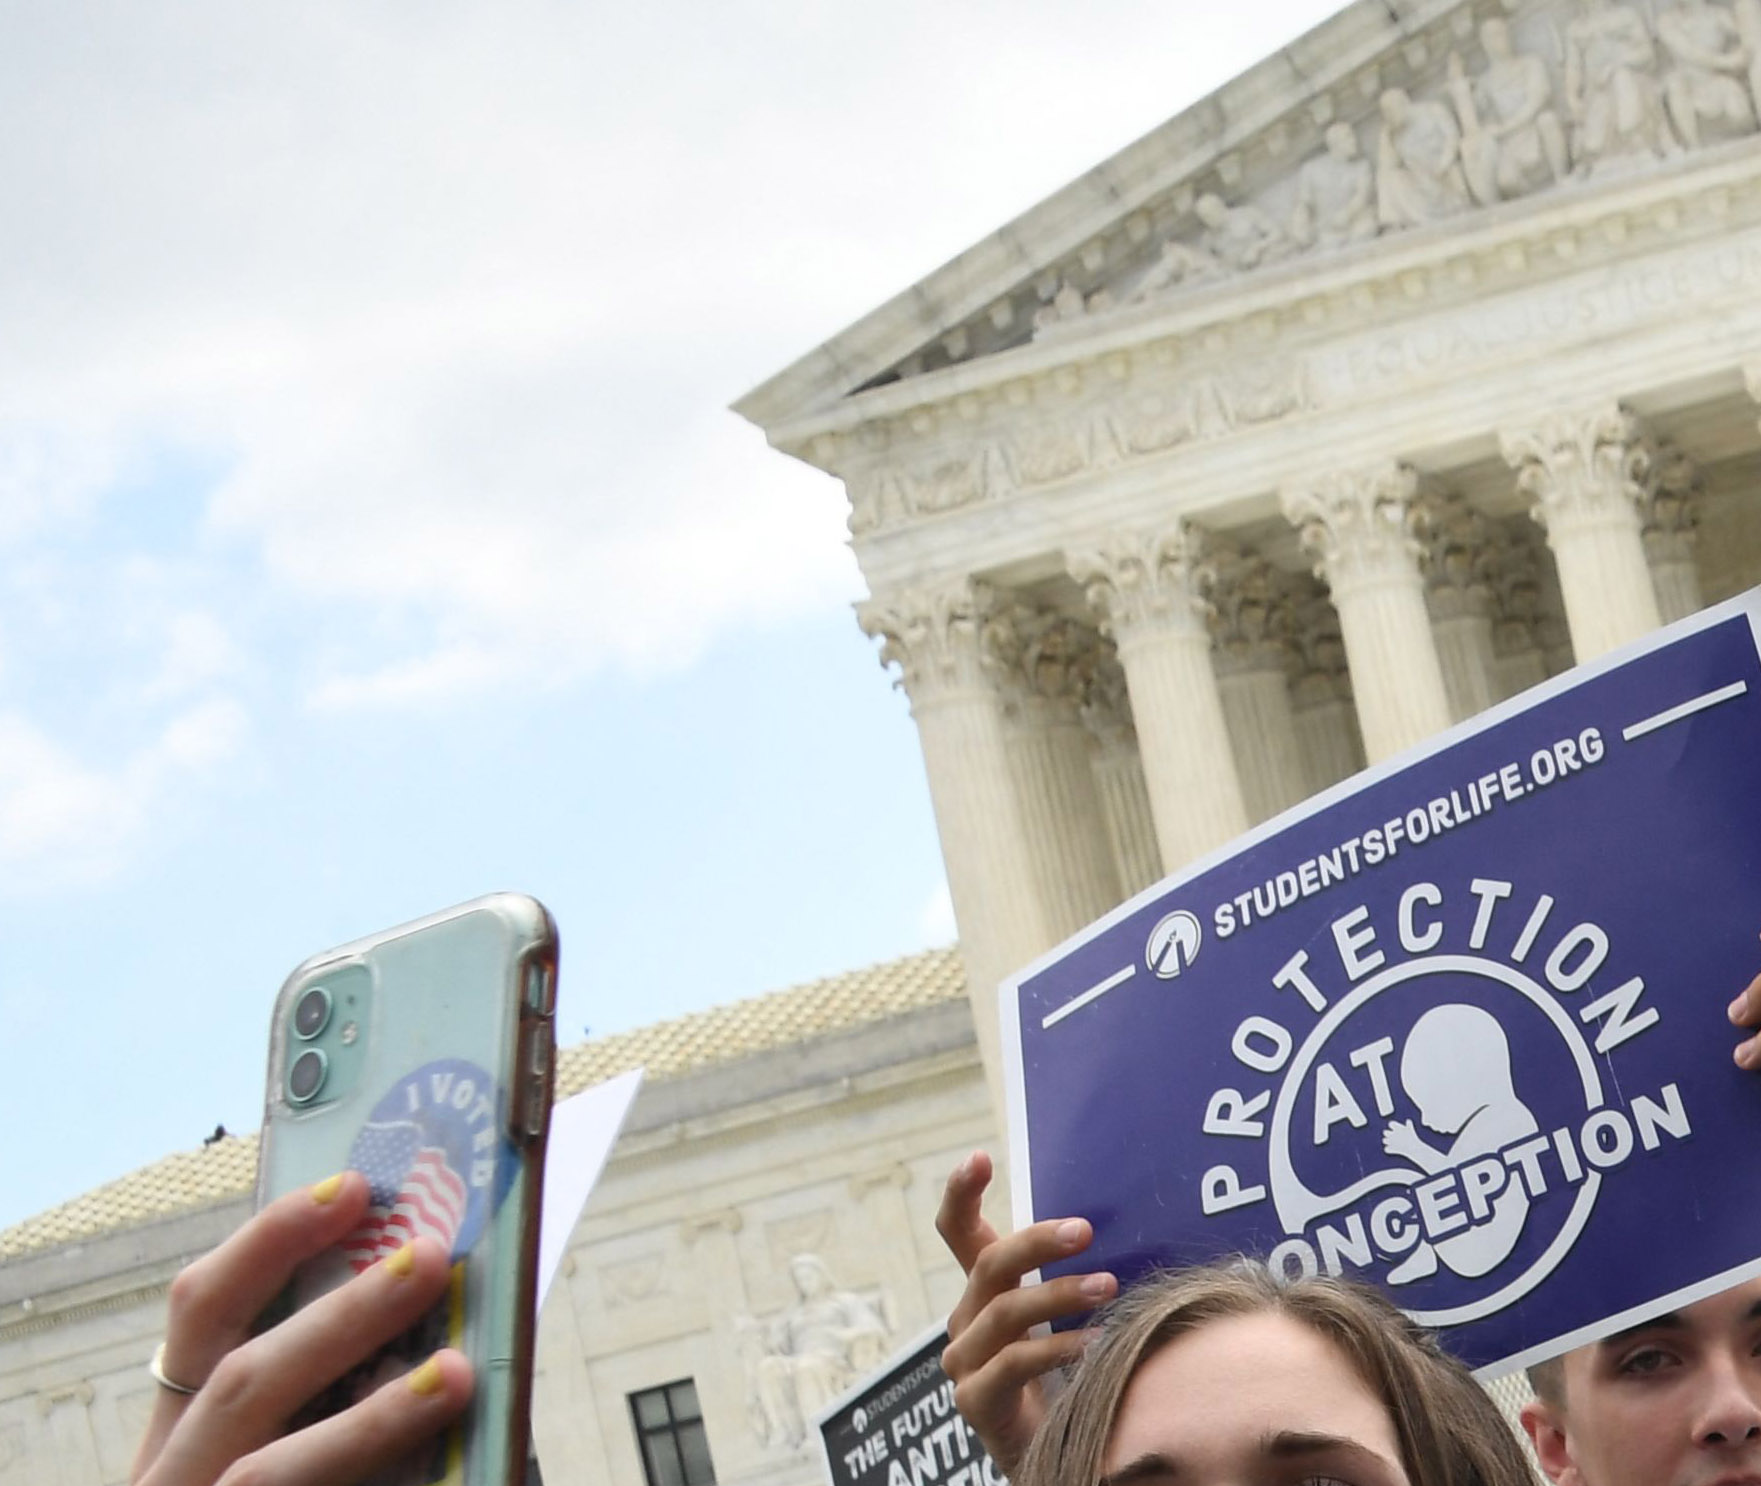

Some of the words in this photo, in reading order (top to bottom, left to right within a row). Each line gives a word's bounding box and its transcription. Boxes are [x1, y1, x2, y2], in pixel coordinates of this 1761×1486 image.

[1522, 262, 1692, 338] JUSTICE
[1214, 727, 1604, 940] STUDENTSFORLIFE.ORG
[1202, 878, 1660, 1214] PROTECTION
[1313, 1037, 1394, 1146] AT
[1268, 1083, 1692, 1286] ONCEPTION
[843, 1430, 889, 1480] THE
